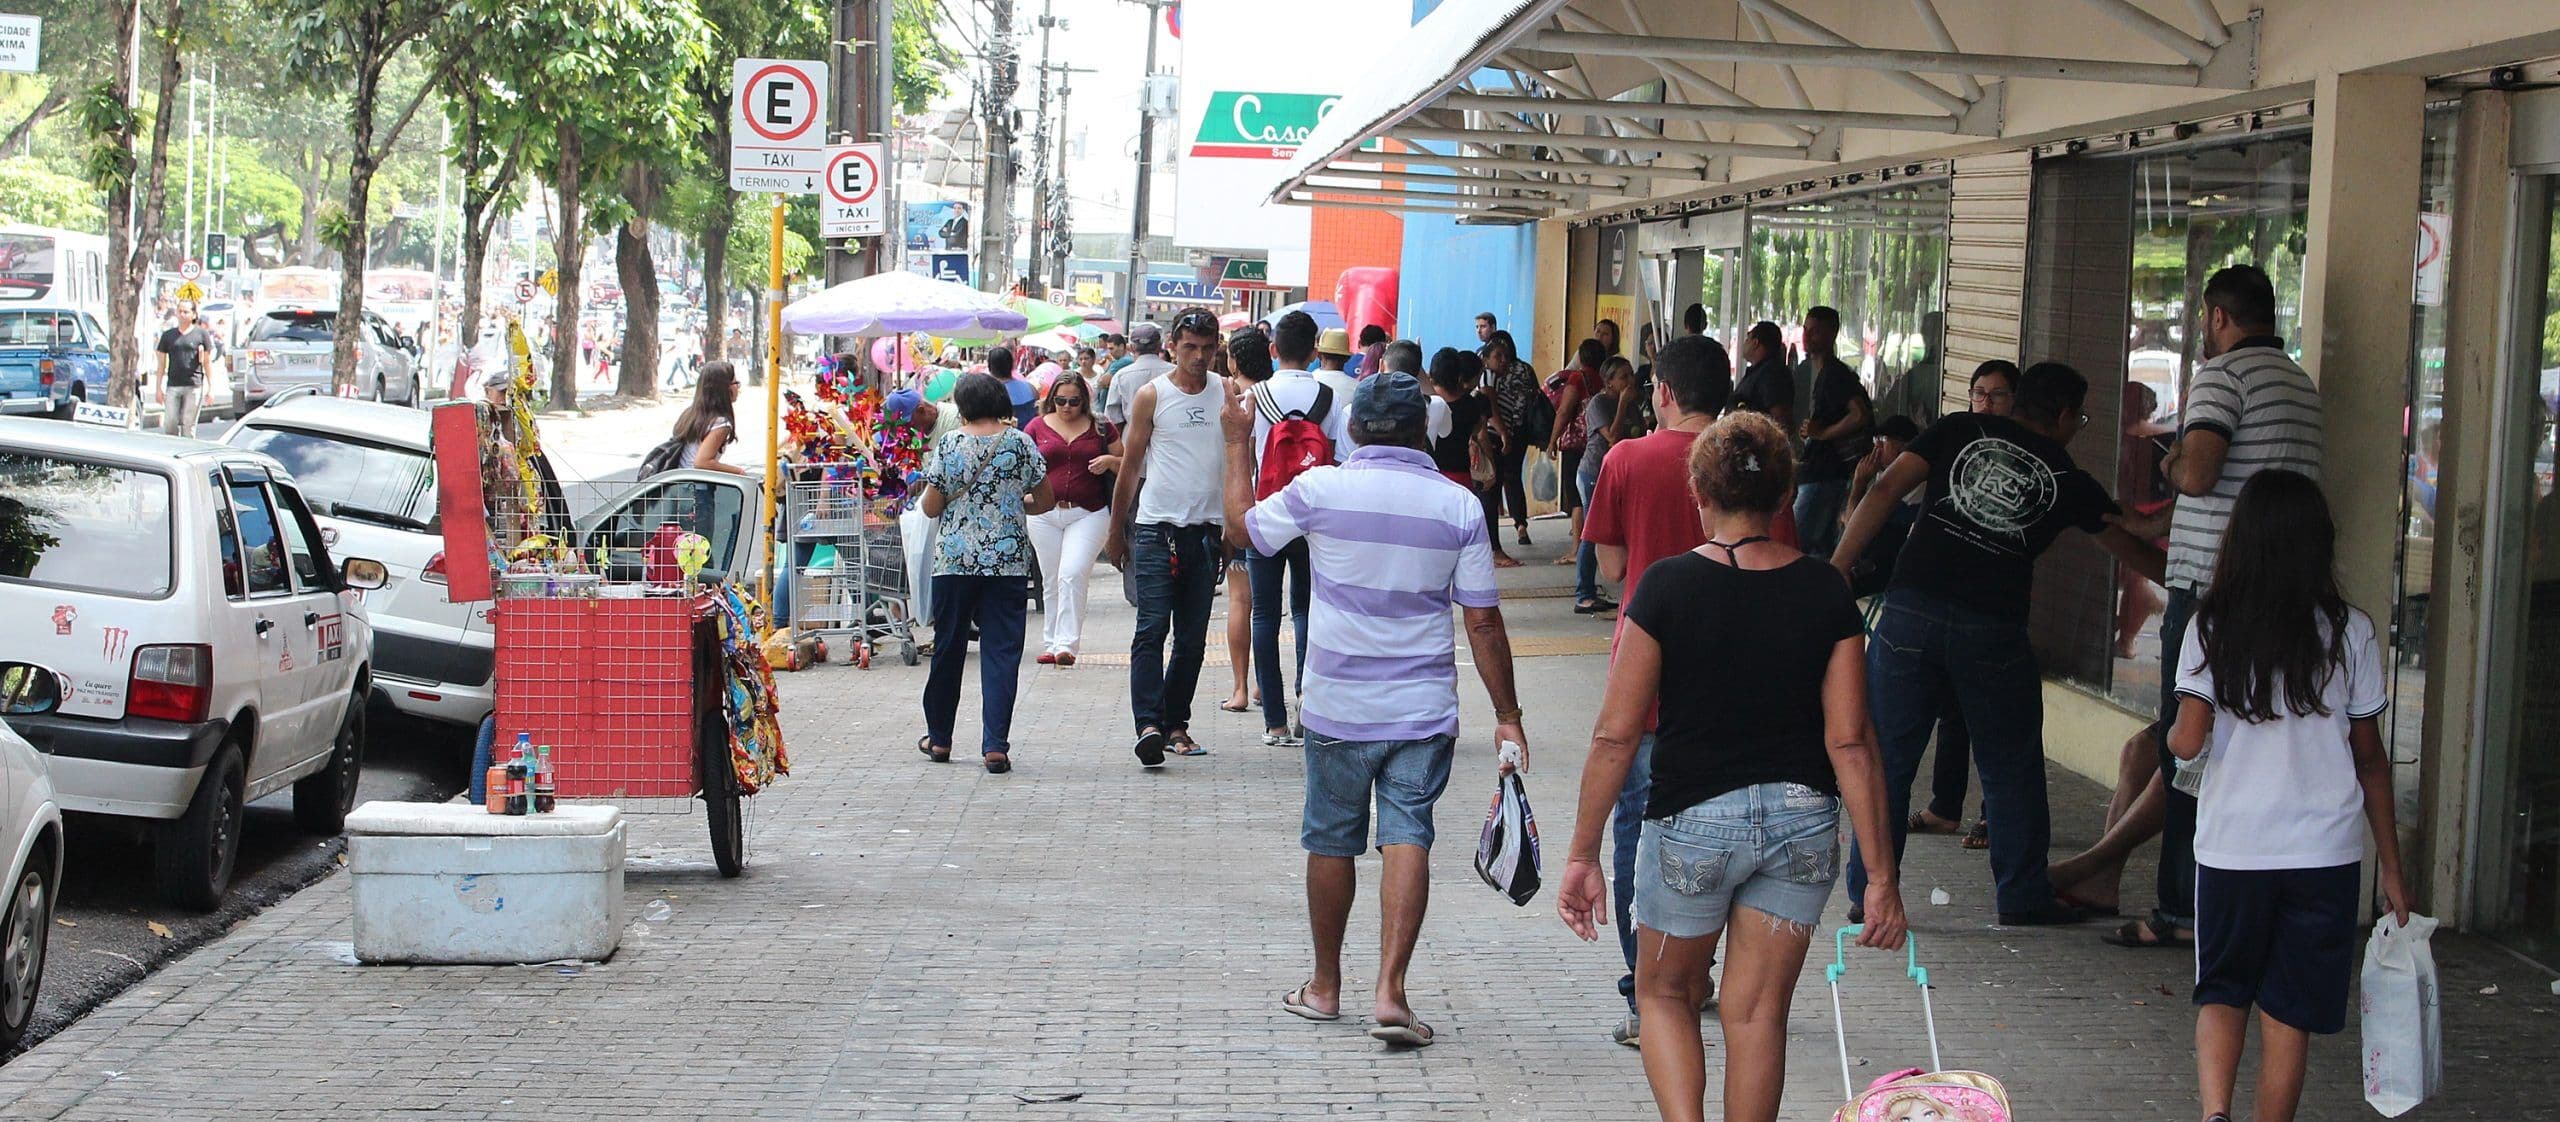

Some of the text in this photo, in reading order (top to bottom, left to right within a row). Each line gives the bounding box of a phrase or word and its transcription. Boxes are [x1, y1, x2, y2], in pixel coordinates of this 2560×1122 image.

[766, 81, 794, 125] E
[762, 152, 794, 167] TÁXI
[738, 175, 790, 189] TÉRMINO
[842, 162, 862, 193] E
[838, 206, 869, 219] TÁXI
[183, 264, 199, 274] 20
[79, 406, 126, 421] TAXI
